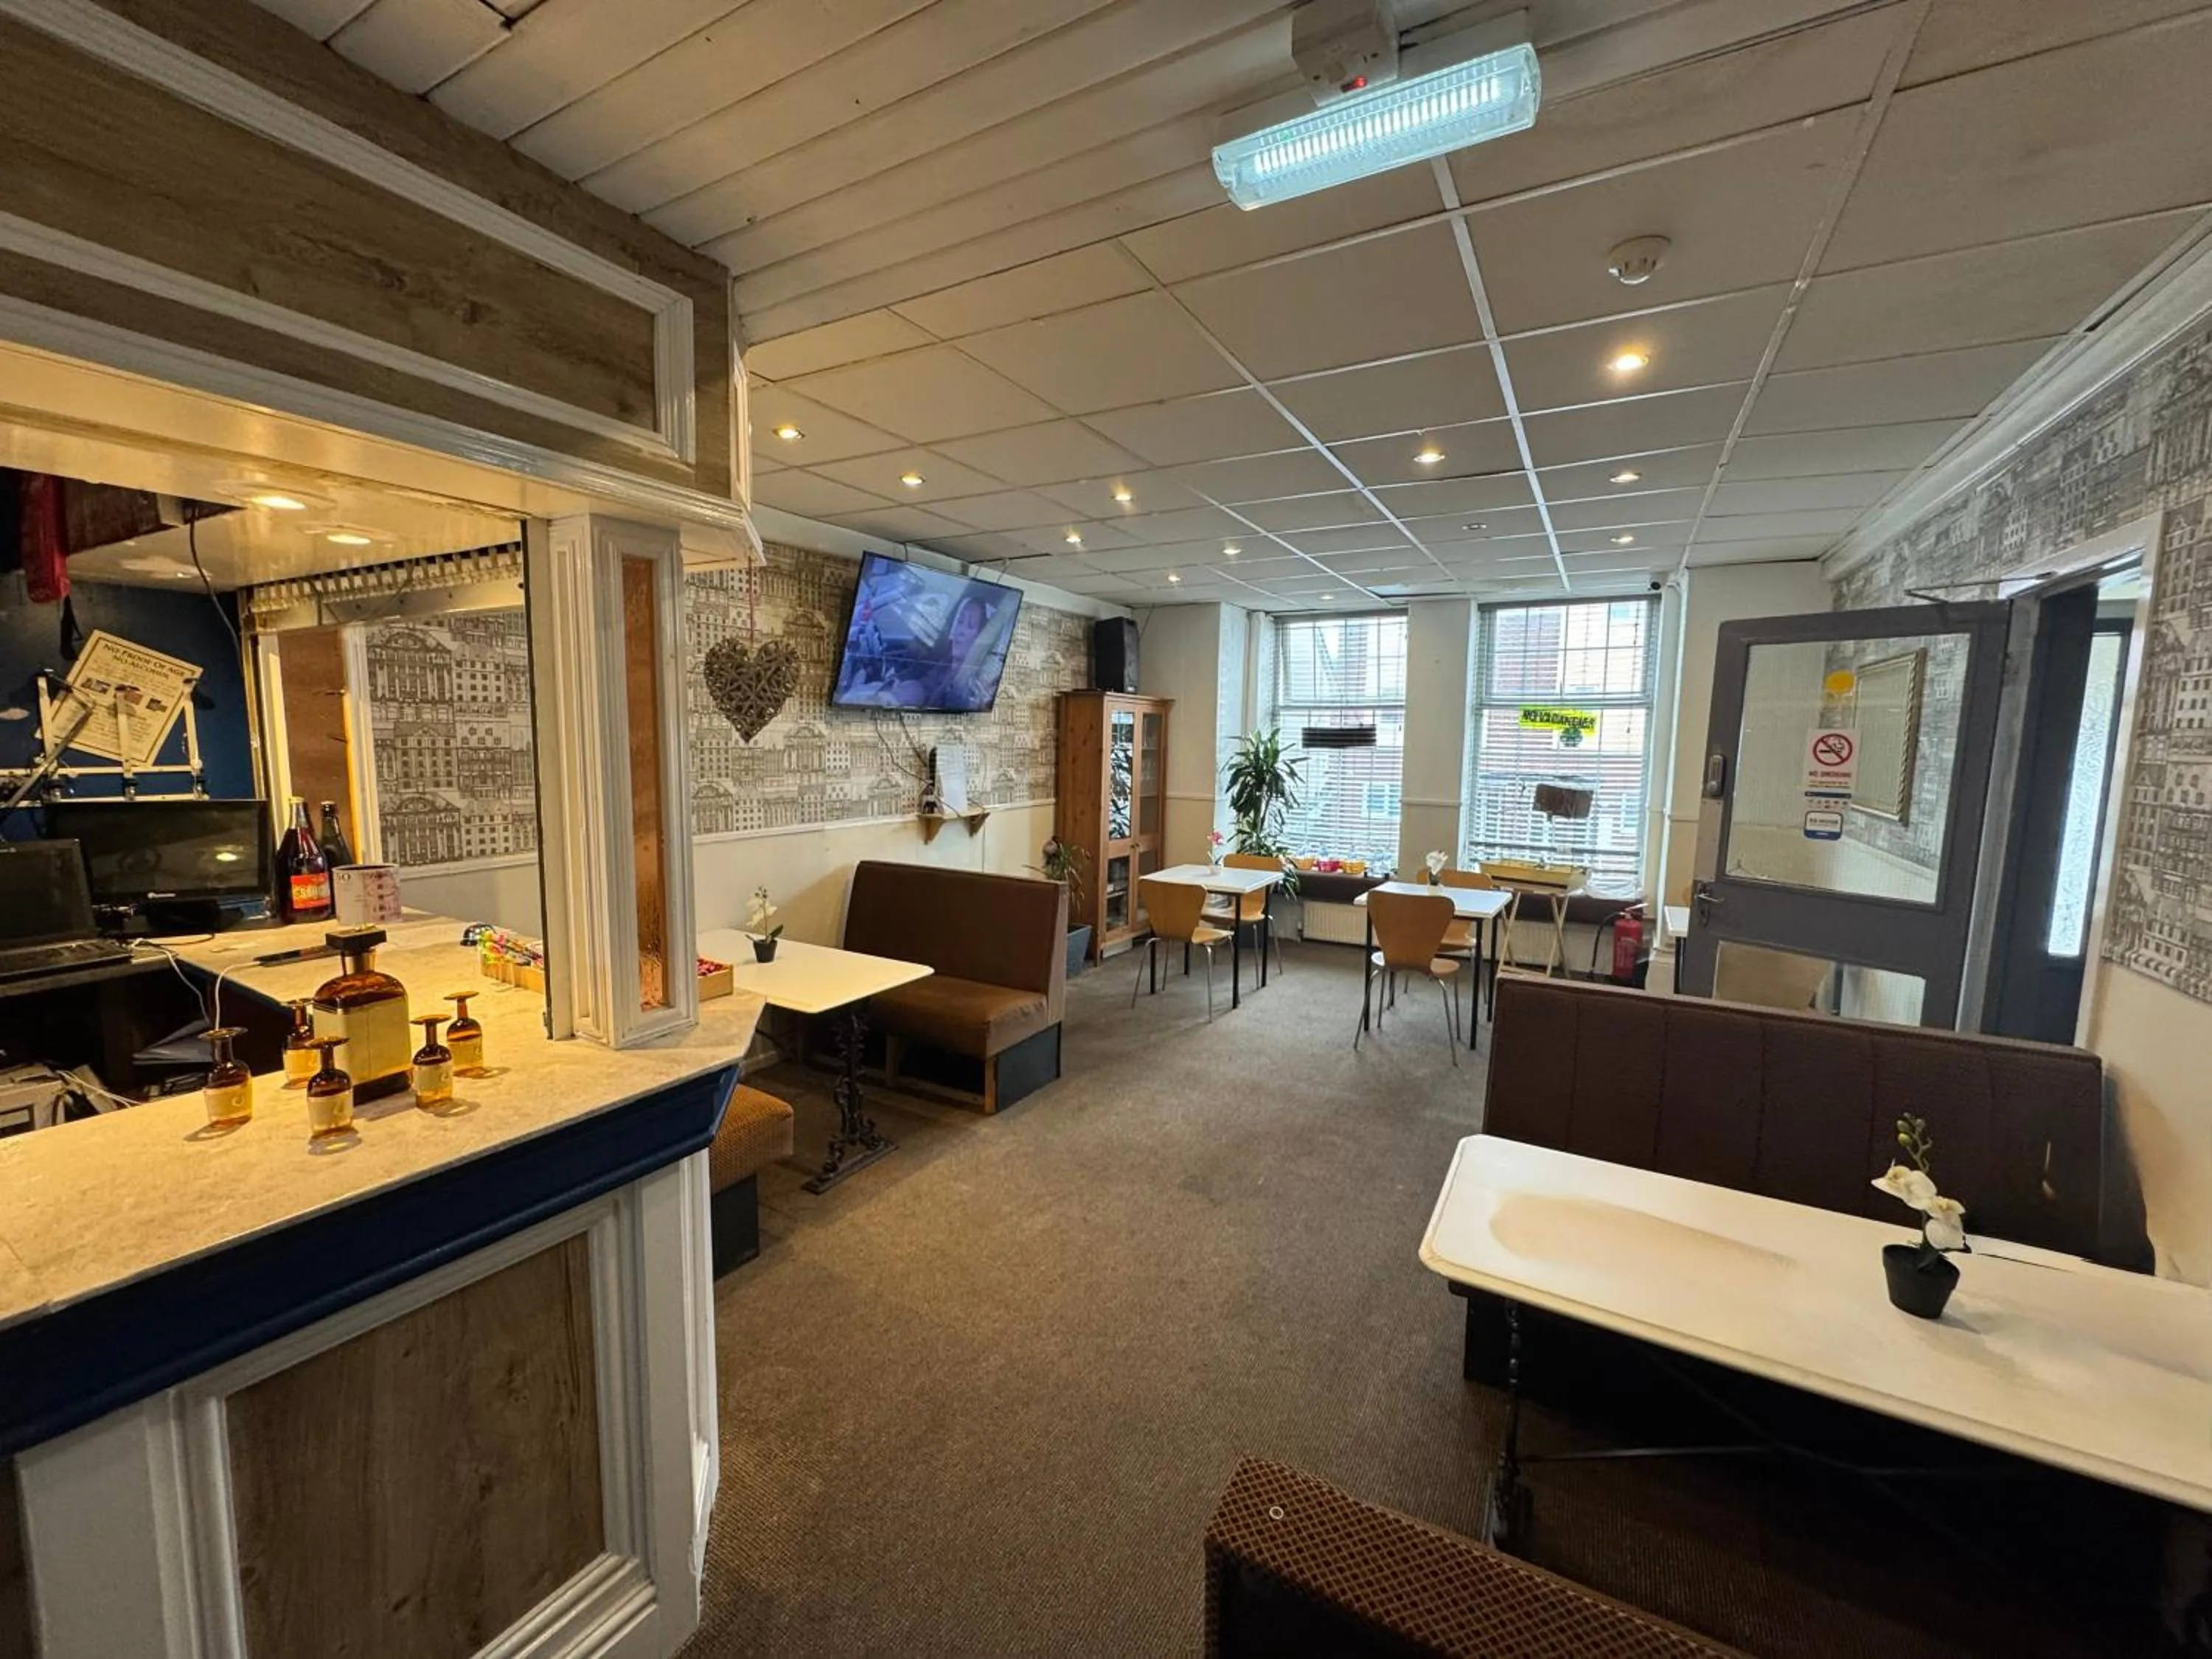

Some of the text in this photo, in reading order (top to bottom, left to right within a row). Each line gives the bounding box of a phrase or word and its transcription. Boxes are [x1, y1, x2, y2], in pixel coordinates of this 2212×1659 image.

[104, 642, 121, 654] NO
[121, 650, 151, 665] PROOF
[167, 667, 184, 677] AGE
[113, 655, 128, 664] NO
